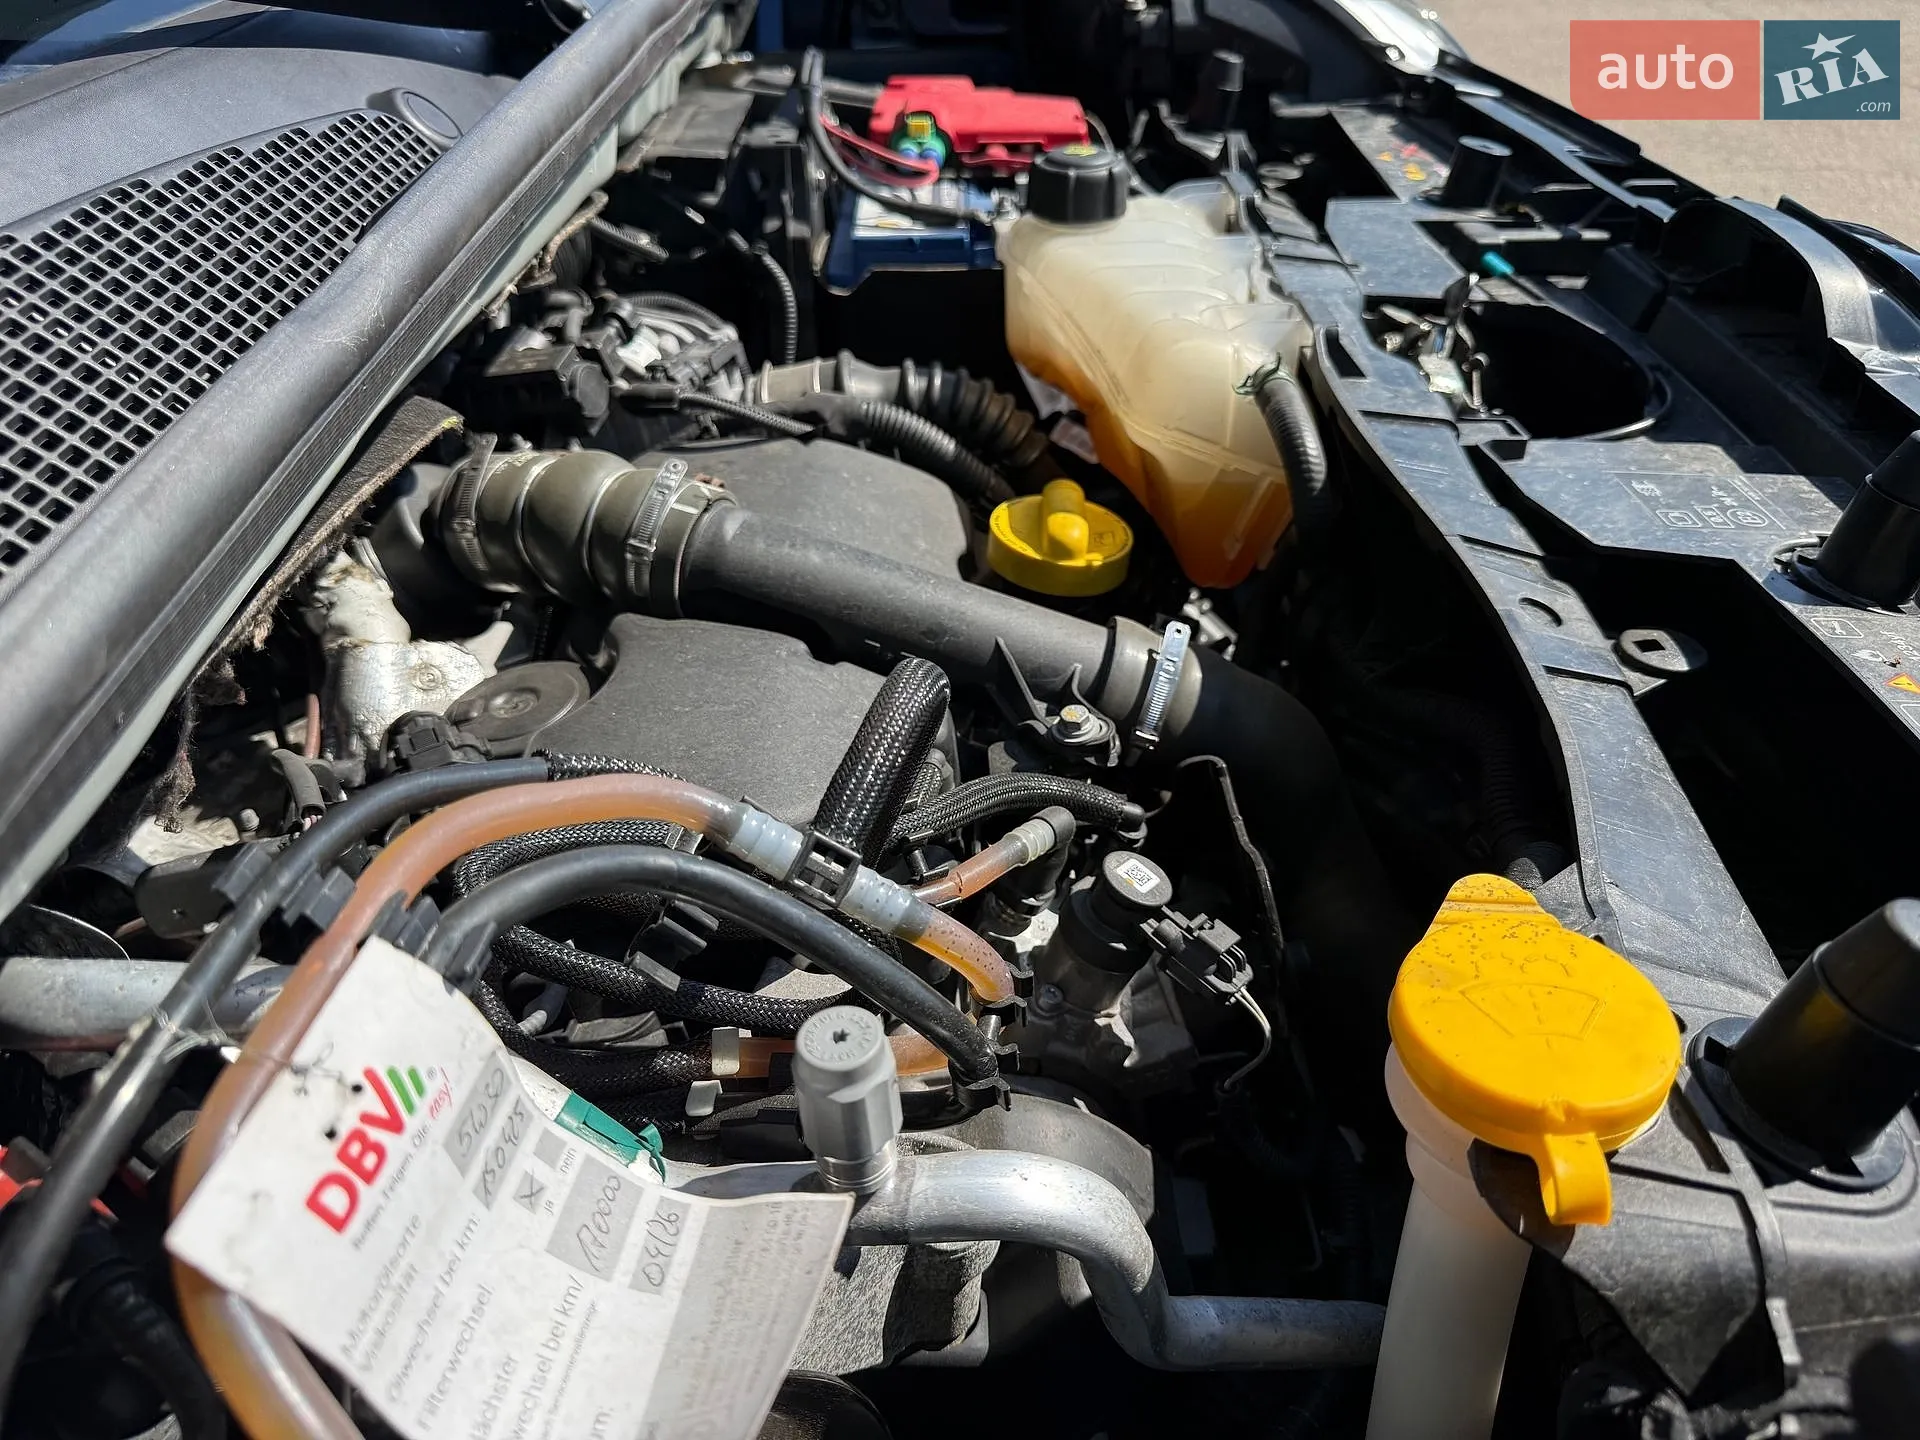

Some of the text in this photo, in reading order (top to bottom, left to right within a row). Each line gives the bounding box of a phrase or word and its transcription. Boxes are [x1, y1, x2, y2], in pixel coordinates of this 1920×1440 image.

[304, 1066, 404, 1234] DBV
[558, 1146, 577, 1174] nein
[437, 1251, 461, 1286] bei
[540, 1318, 567, 1352] bei
